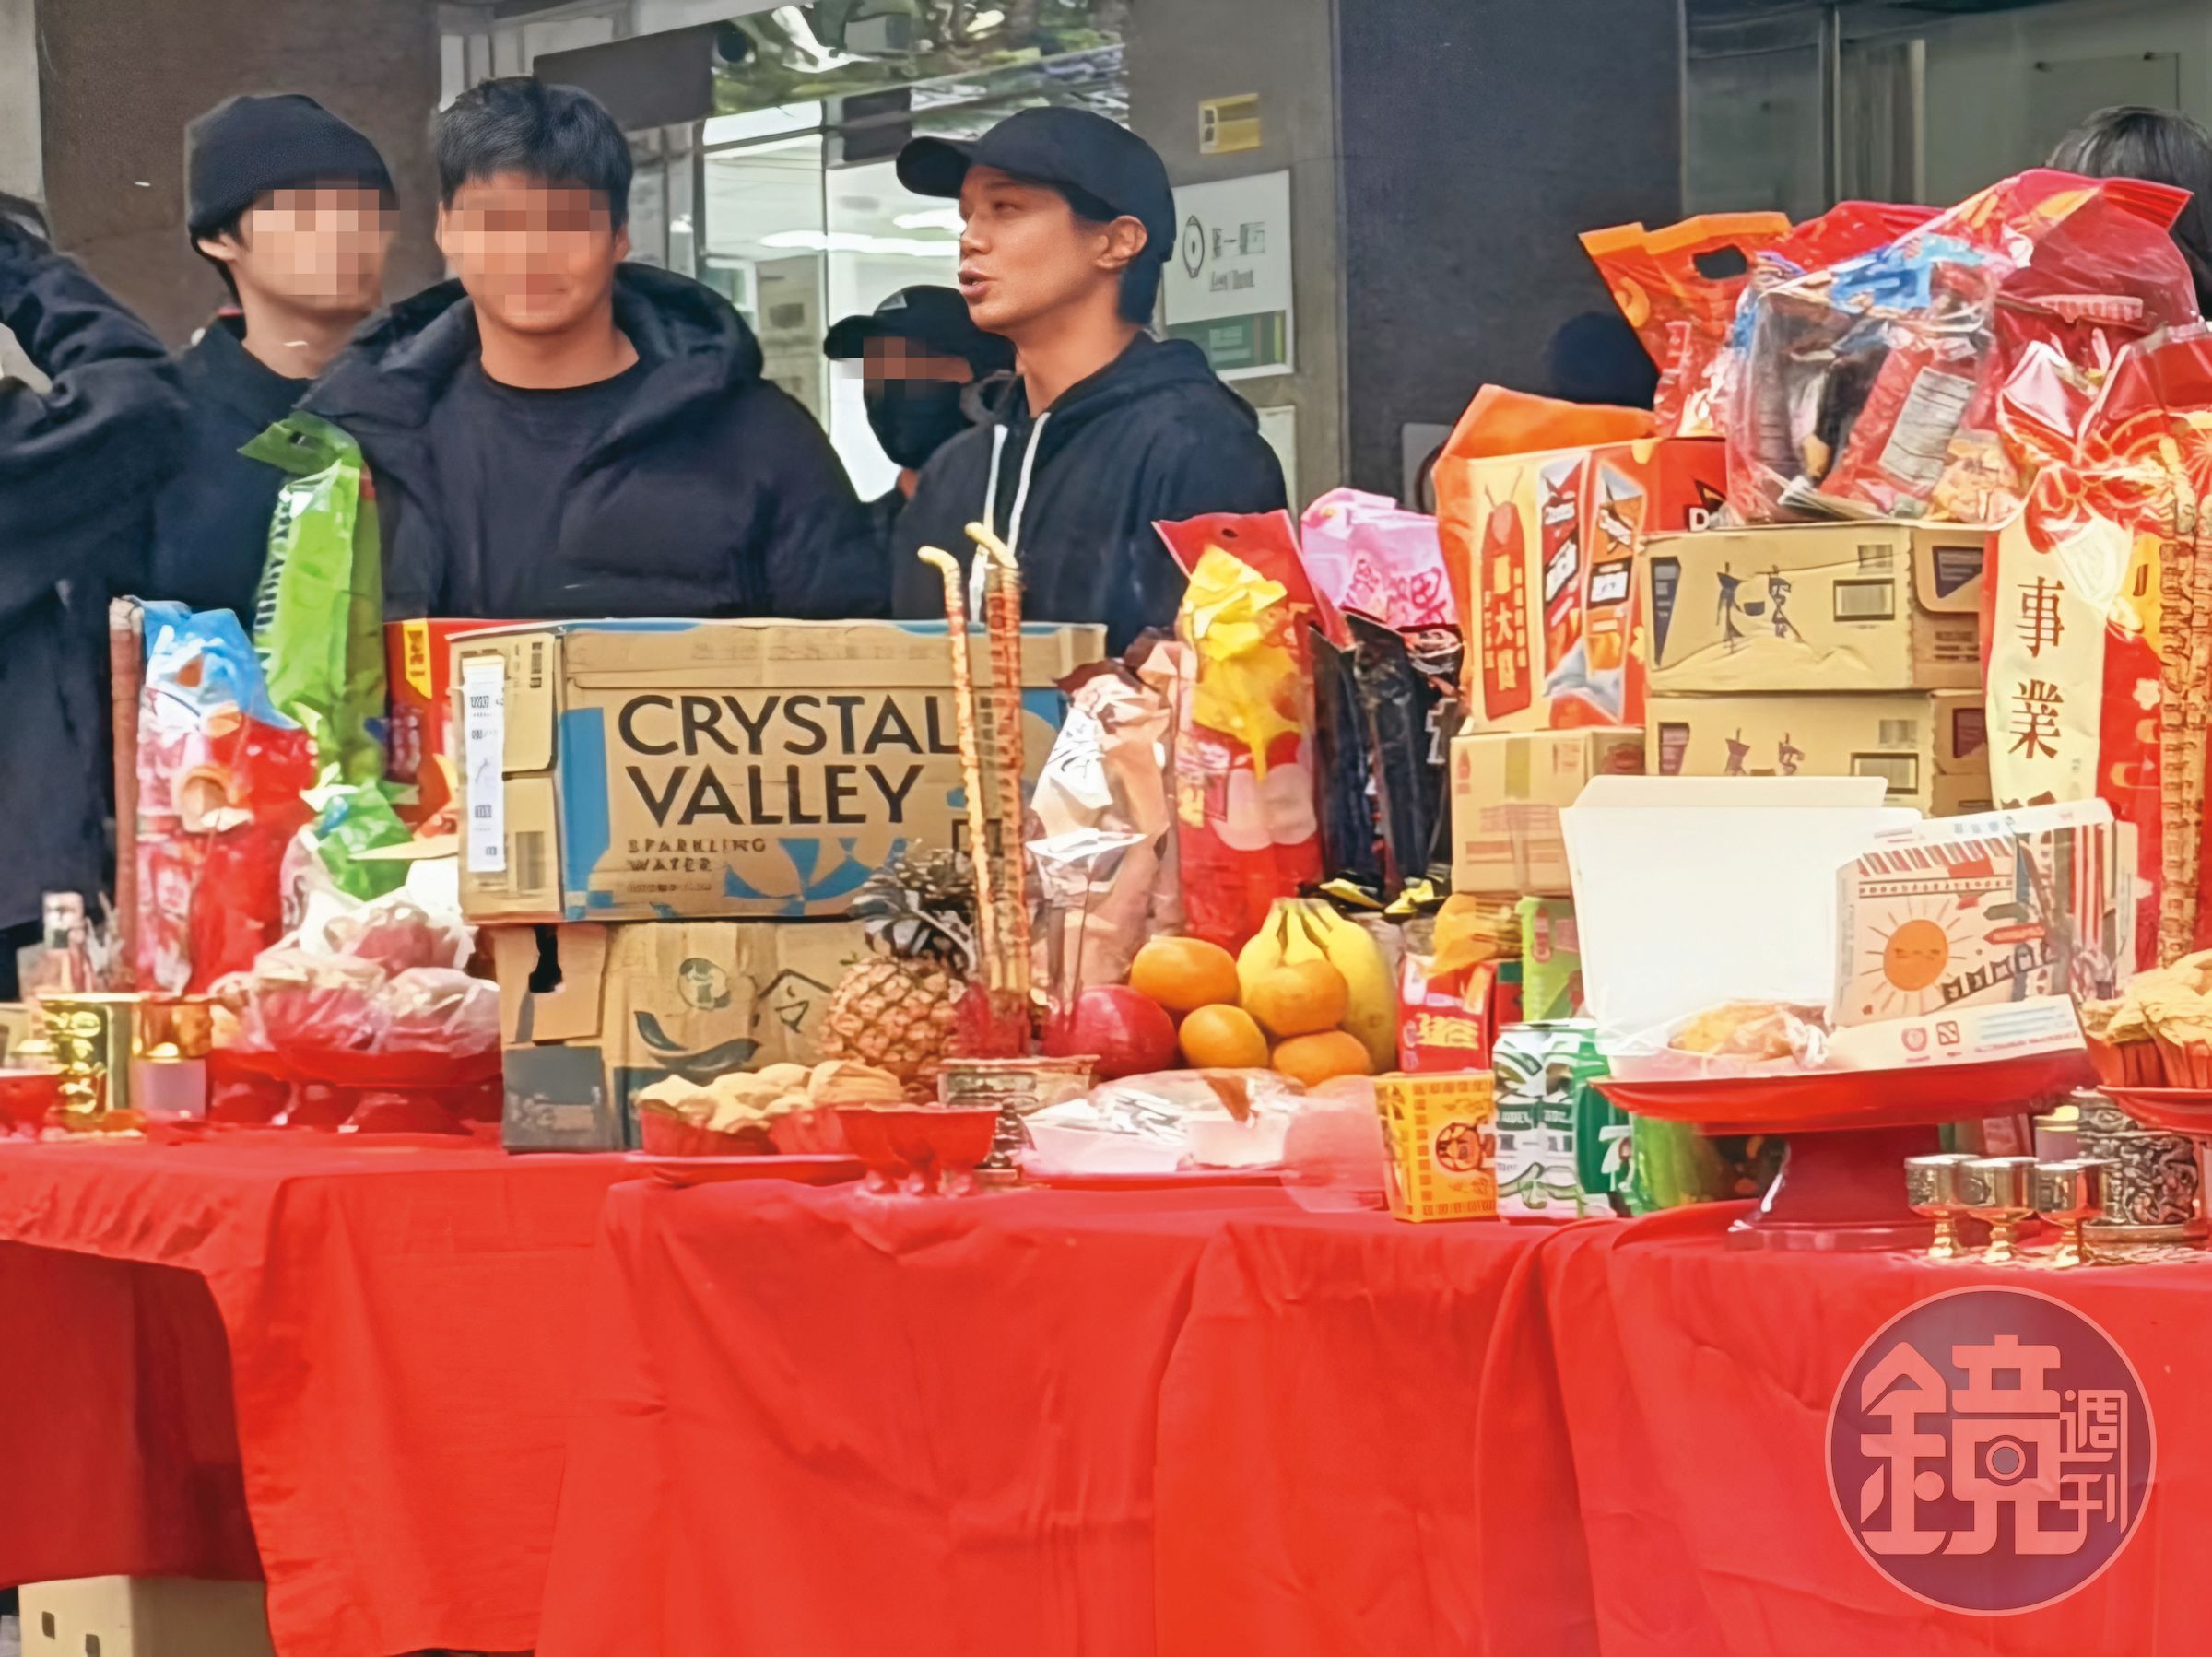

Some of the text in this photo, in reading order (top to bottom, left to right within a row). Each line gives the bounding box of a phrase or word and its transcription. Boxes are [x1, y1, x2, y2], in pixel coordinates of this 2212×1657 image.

[2001, 576, 2065, 809] 事業
[618, 694, 960, 756] CRYSTAL
[625, 763, 924, 828] VALLEY
[628, 857, 712, 872] WATER
